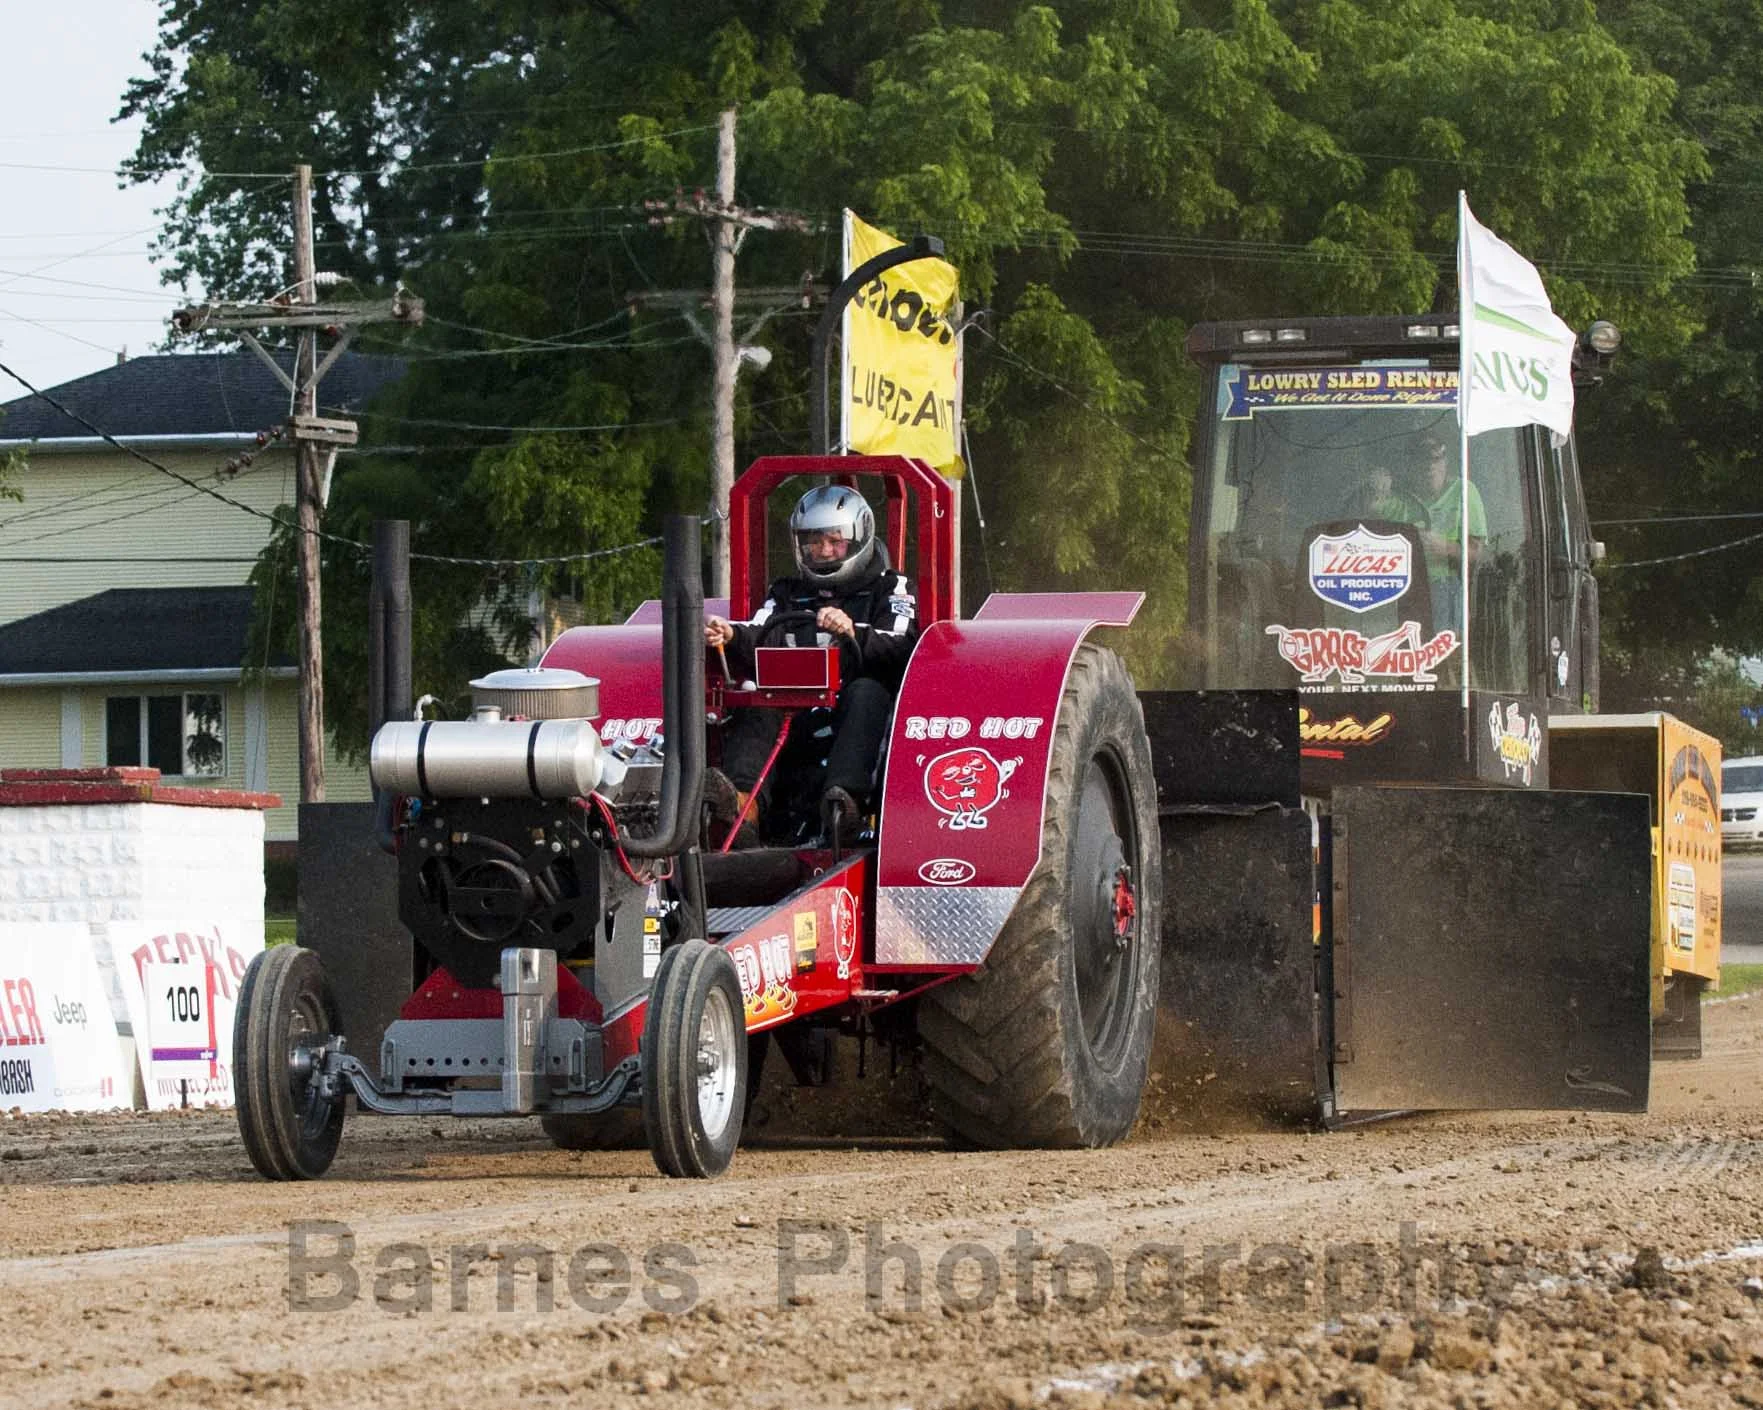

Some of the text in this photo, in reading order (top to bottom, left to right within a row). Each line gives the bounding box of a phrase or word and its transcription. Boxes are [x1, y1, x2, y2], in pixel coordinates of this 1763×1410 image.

[1248, 371, 1460, 390] LOWRY SLED RENTA
[1322, 555, 1402, 573] LUCAS
[1317, 579, 1404, 589] OIL PRODUCTS
[1349, 591, 1373, 601] INC.
[1342, 684, 1379, 693] NEXT
[1381, 684, 1437, 693] MOWER
[601, 718, 663, 740] HOT
[905, 716, 1044, 740] RED HOT
[928, 861, 965, 880] Ford
[728, 933, 793, 993] ED HOT
[0, 977, 45, 1046] LER
[53, 993, 87, 1030] Jeep
[166, 986, 200, 1022] 100
[0, 1058, 35, 1096] BASH
